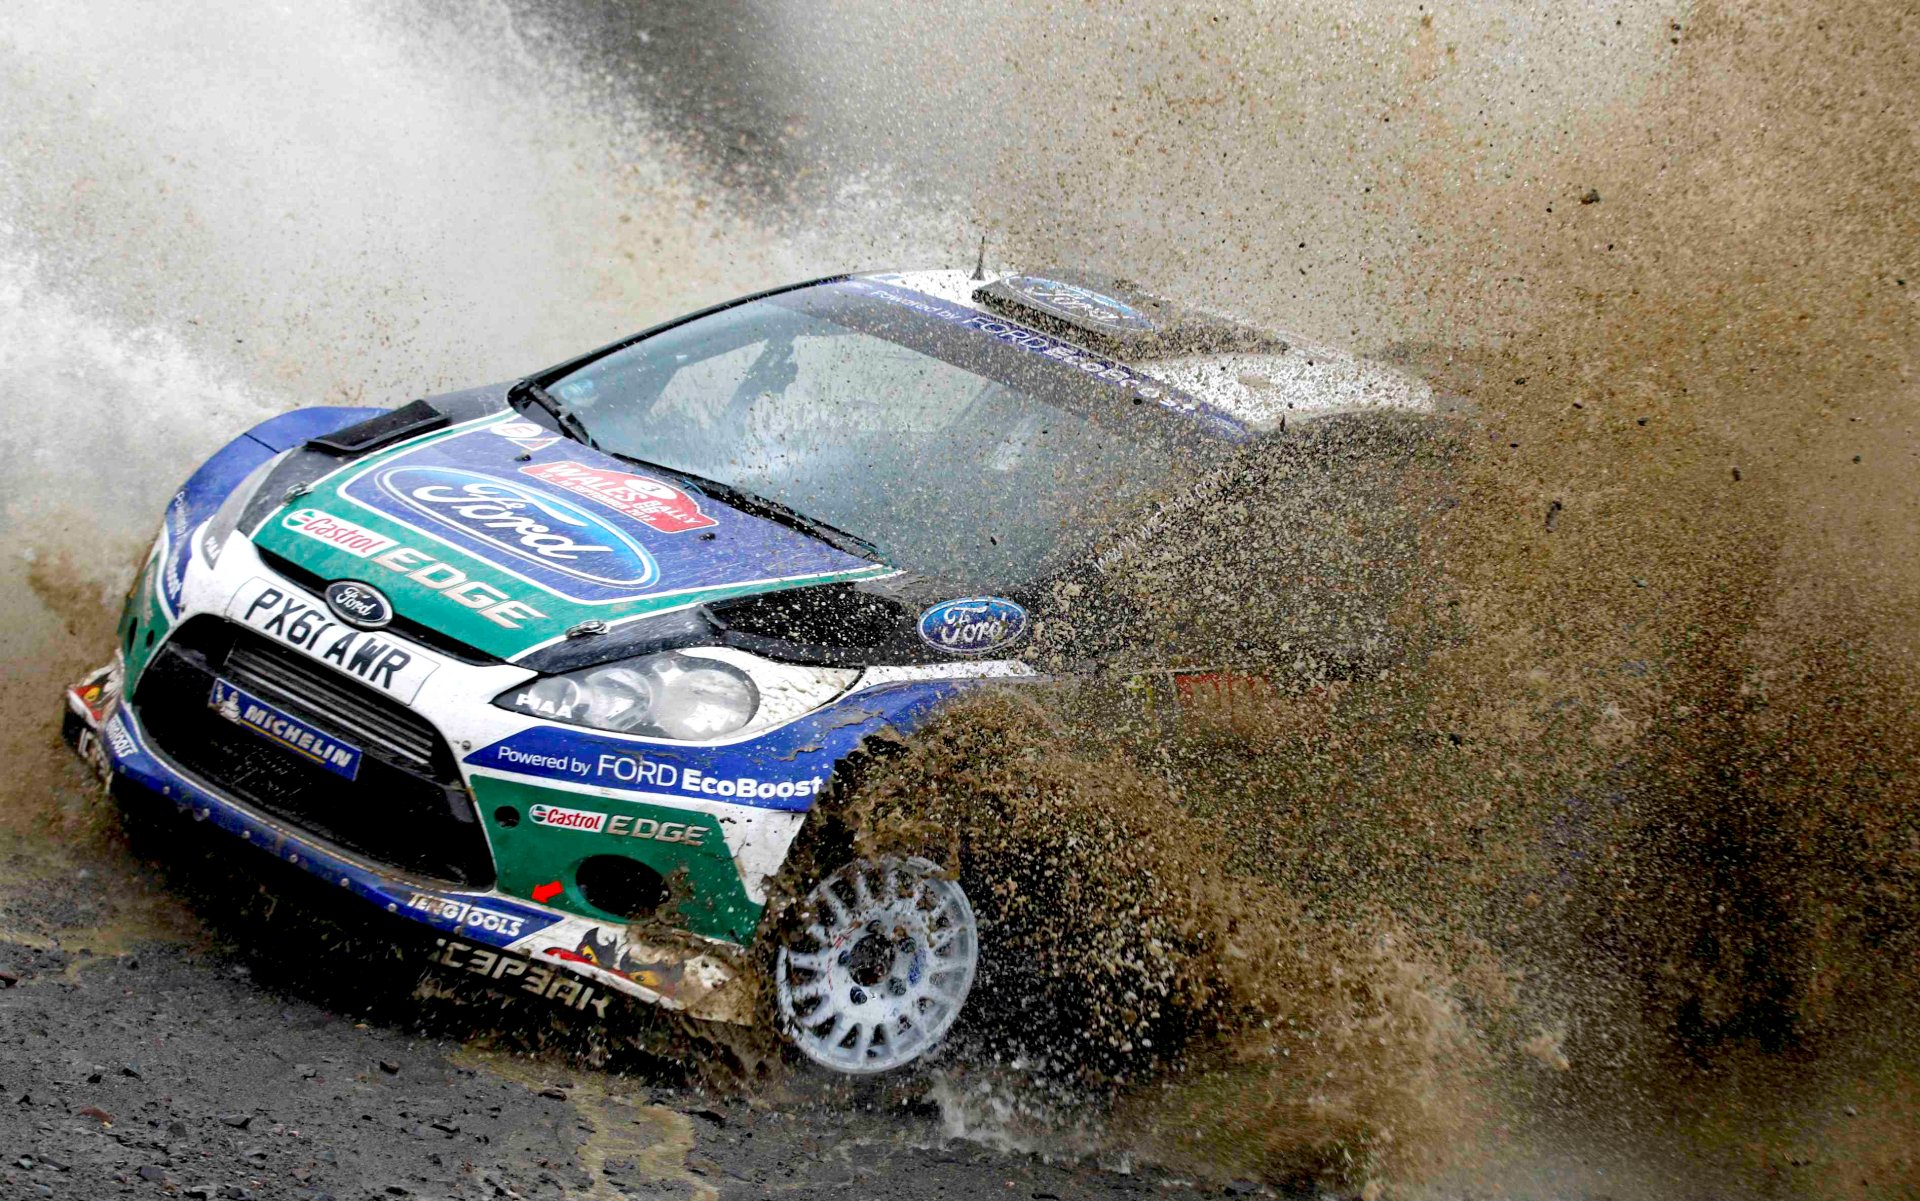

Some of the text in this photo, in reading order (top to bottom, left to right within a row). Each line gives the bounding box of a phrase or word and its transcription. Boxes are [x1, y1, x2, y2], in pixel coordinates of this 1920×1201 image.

[962, 317, 1050, 351] FORD
[545, 464, 648, 502] WALES
[412, 483, 614, 560] Ford
[302, 515, 549, 630] Castrol EDGE
[336, 587, 376, 616] Ford
[244, 587, 411, 690] PX61 AWR
[940, 606, 1007, 643] Ford
[515, 693, 572, 718] PIAA
[244, 704, 352, 768] MICHELIN
[498, 746, 824, 798] Powered by FORD EcoBoost
[547, 809, 711, 846] Castrol EDGE
